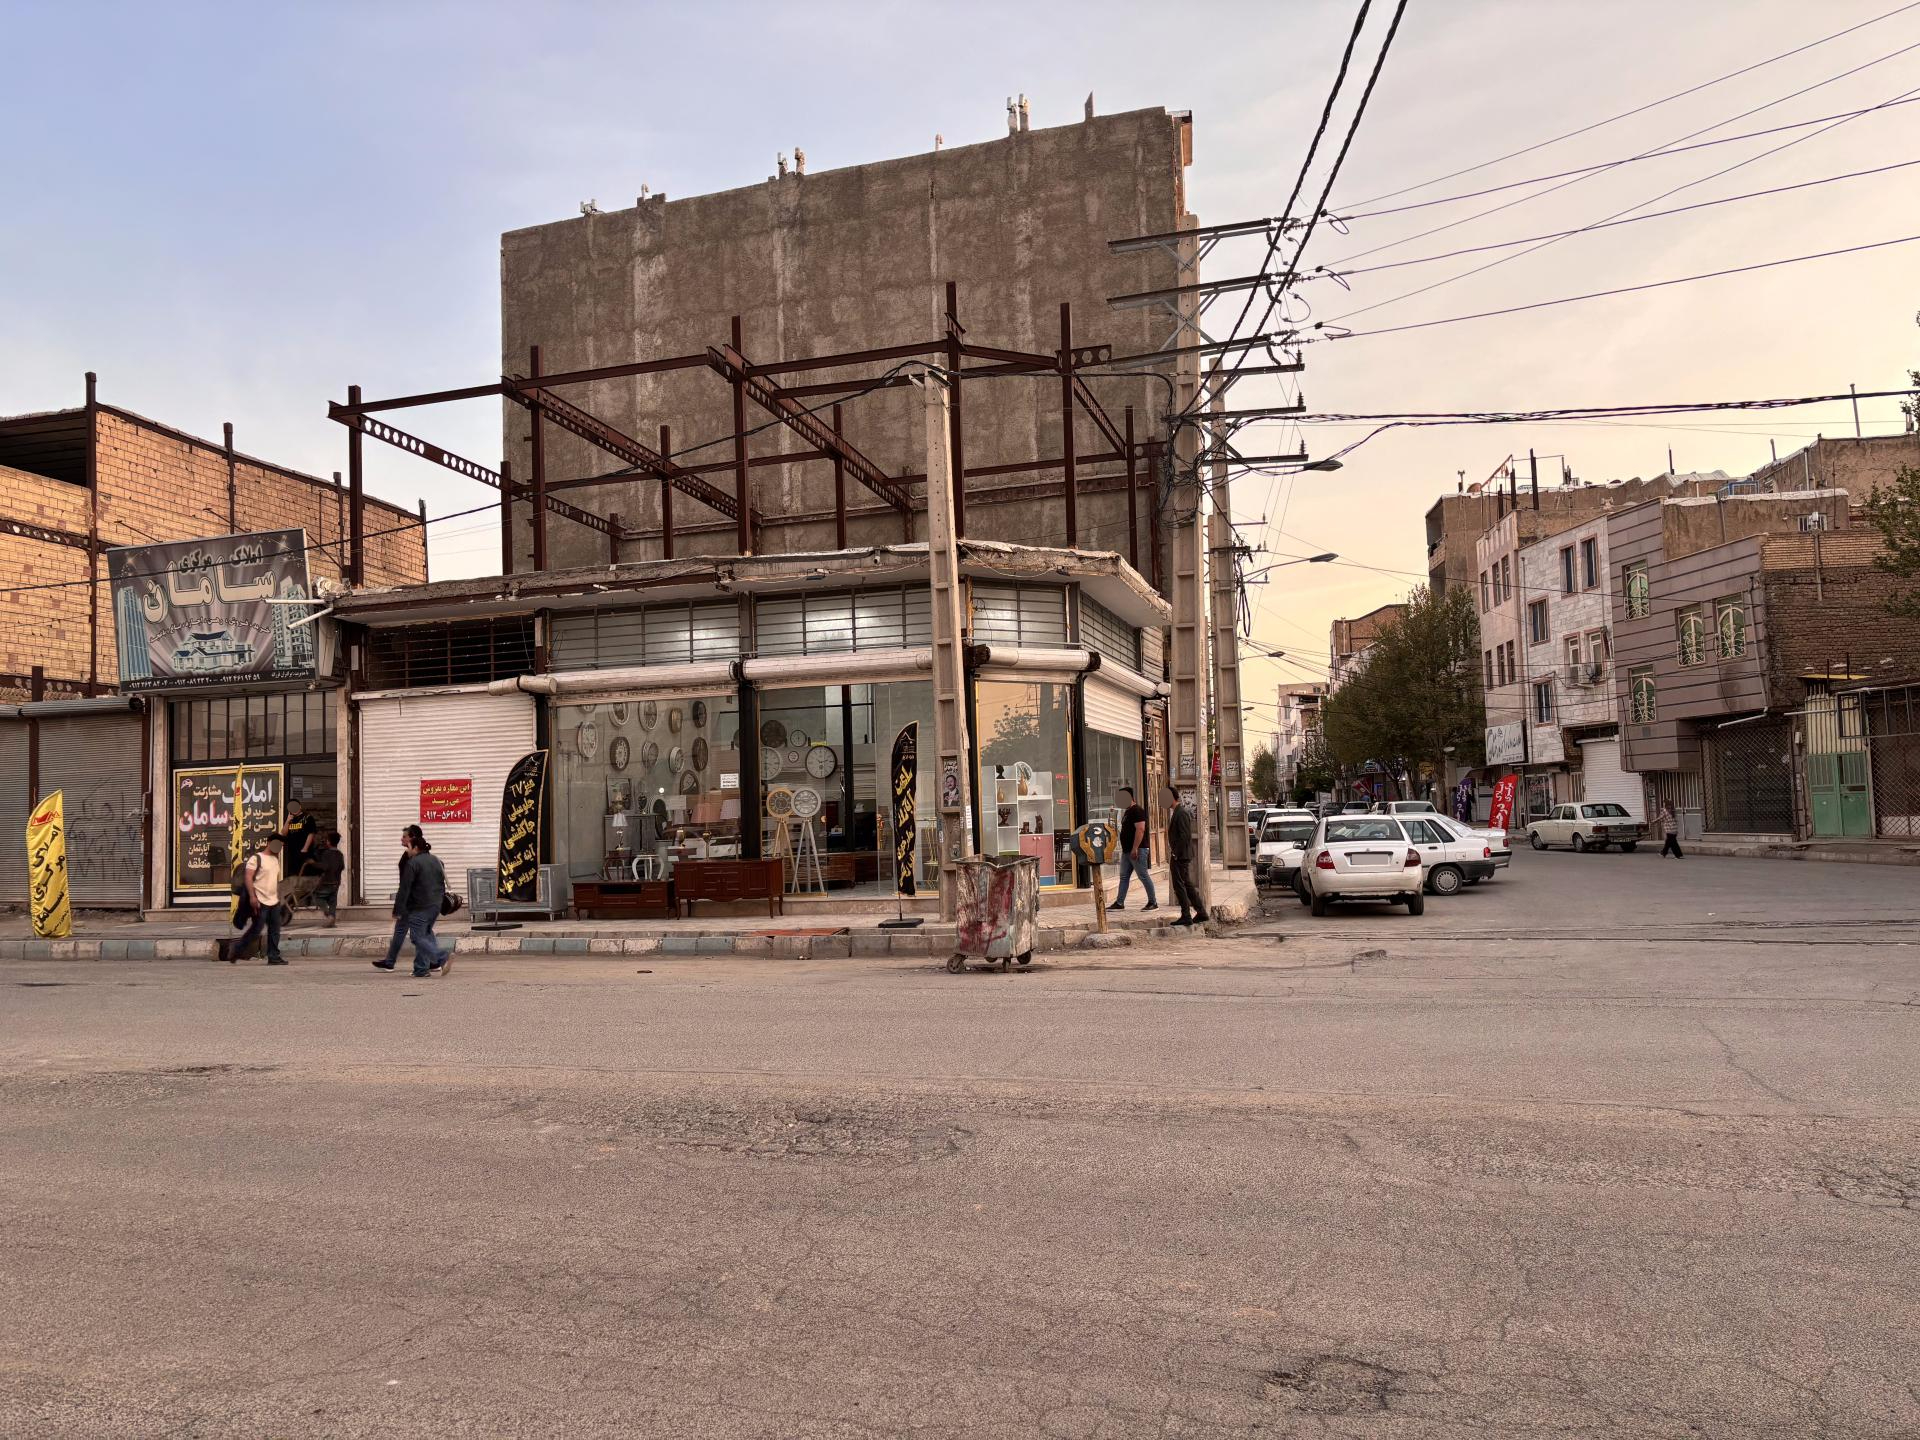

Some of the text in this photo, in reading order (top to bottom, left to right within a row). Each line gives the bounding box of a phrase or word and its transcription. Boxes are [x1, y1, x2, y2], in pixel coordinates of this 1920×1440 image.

[179, 544, 263, 575] املاک مرکزی
[143, 556, 277, 624] سامان
[193, 784, 222, 799] مشارکت
[178, 800, 229, 832] سامان
[253, 804, 276, 819] خرید
[254, 821, 276, 832] رهن
[33, 824, 61, 868] املاک
[34, 855, 65, 902] مرکزی
